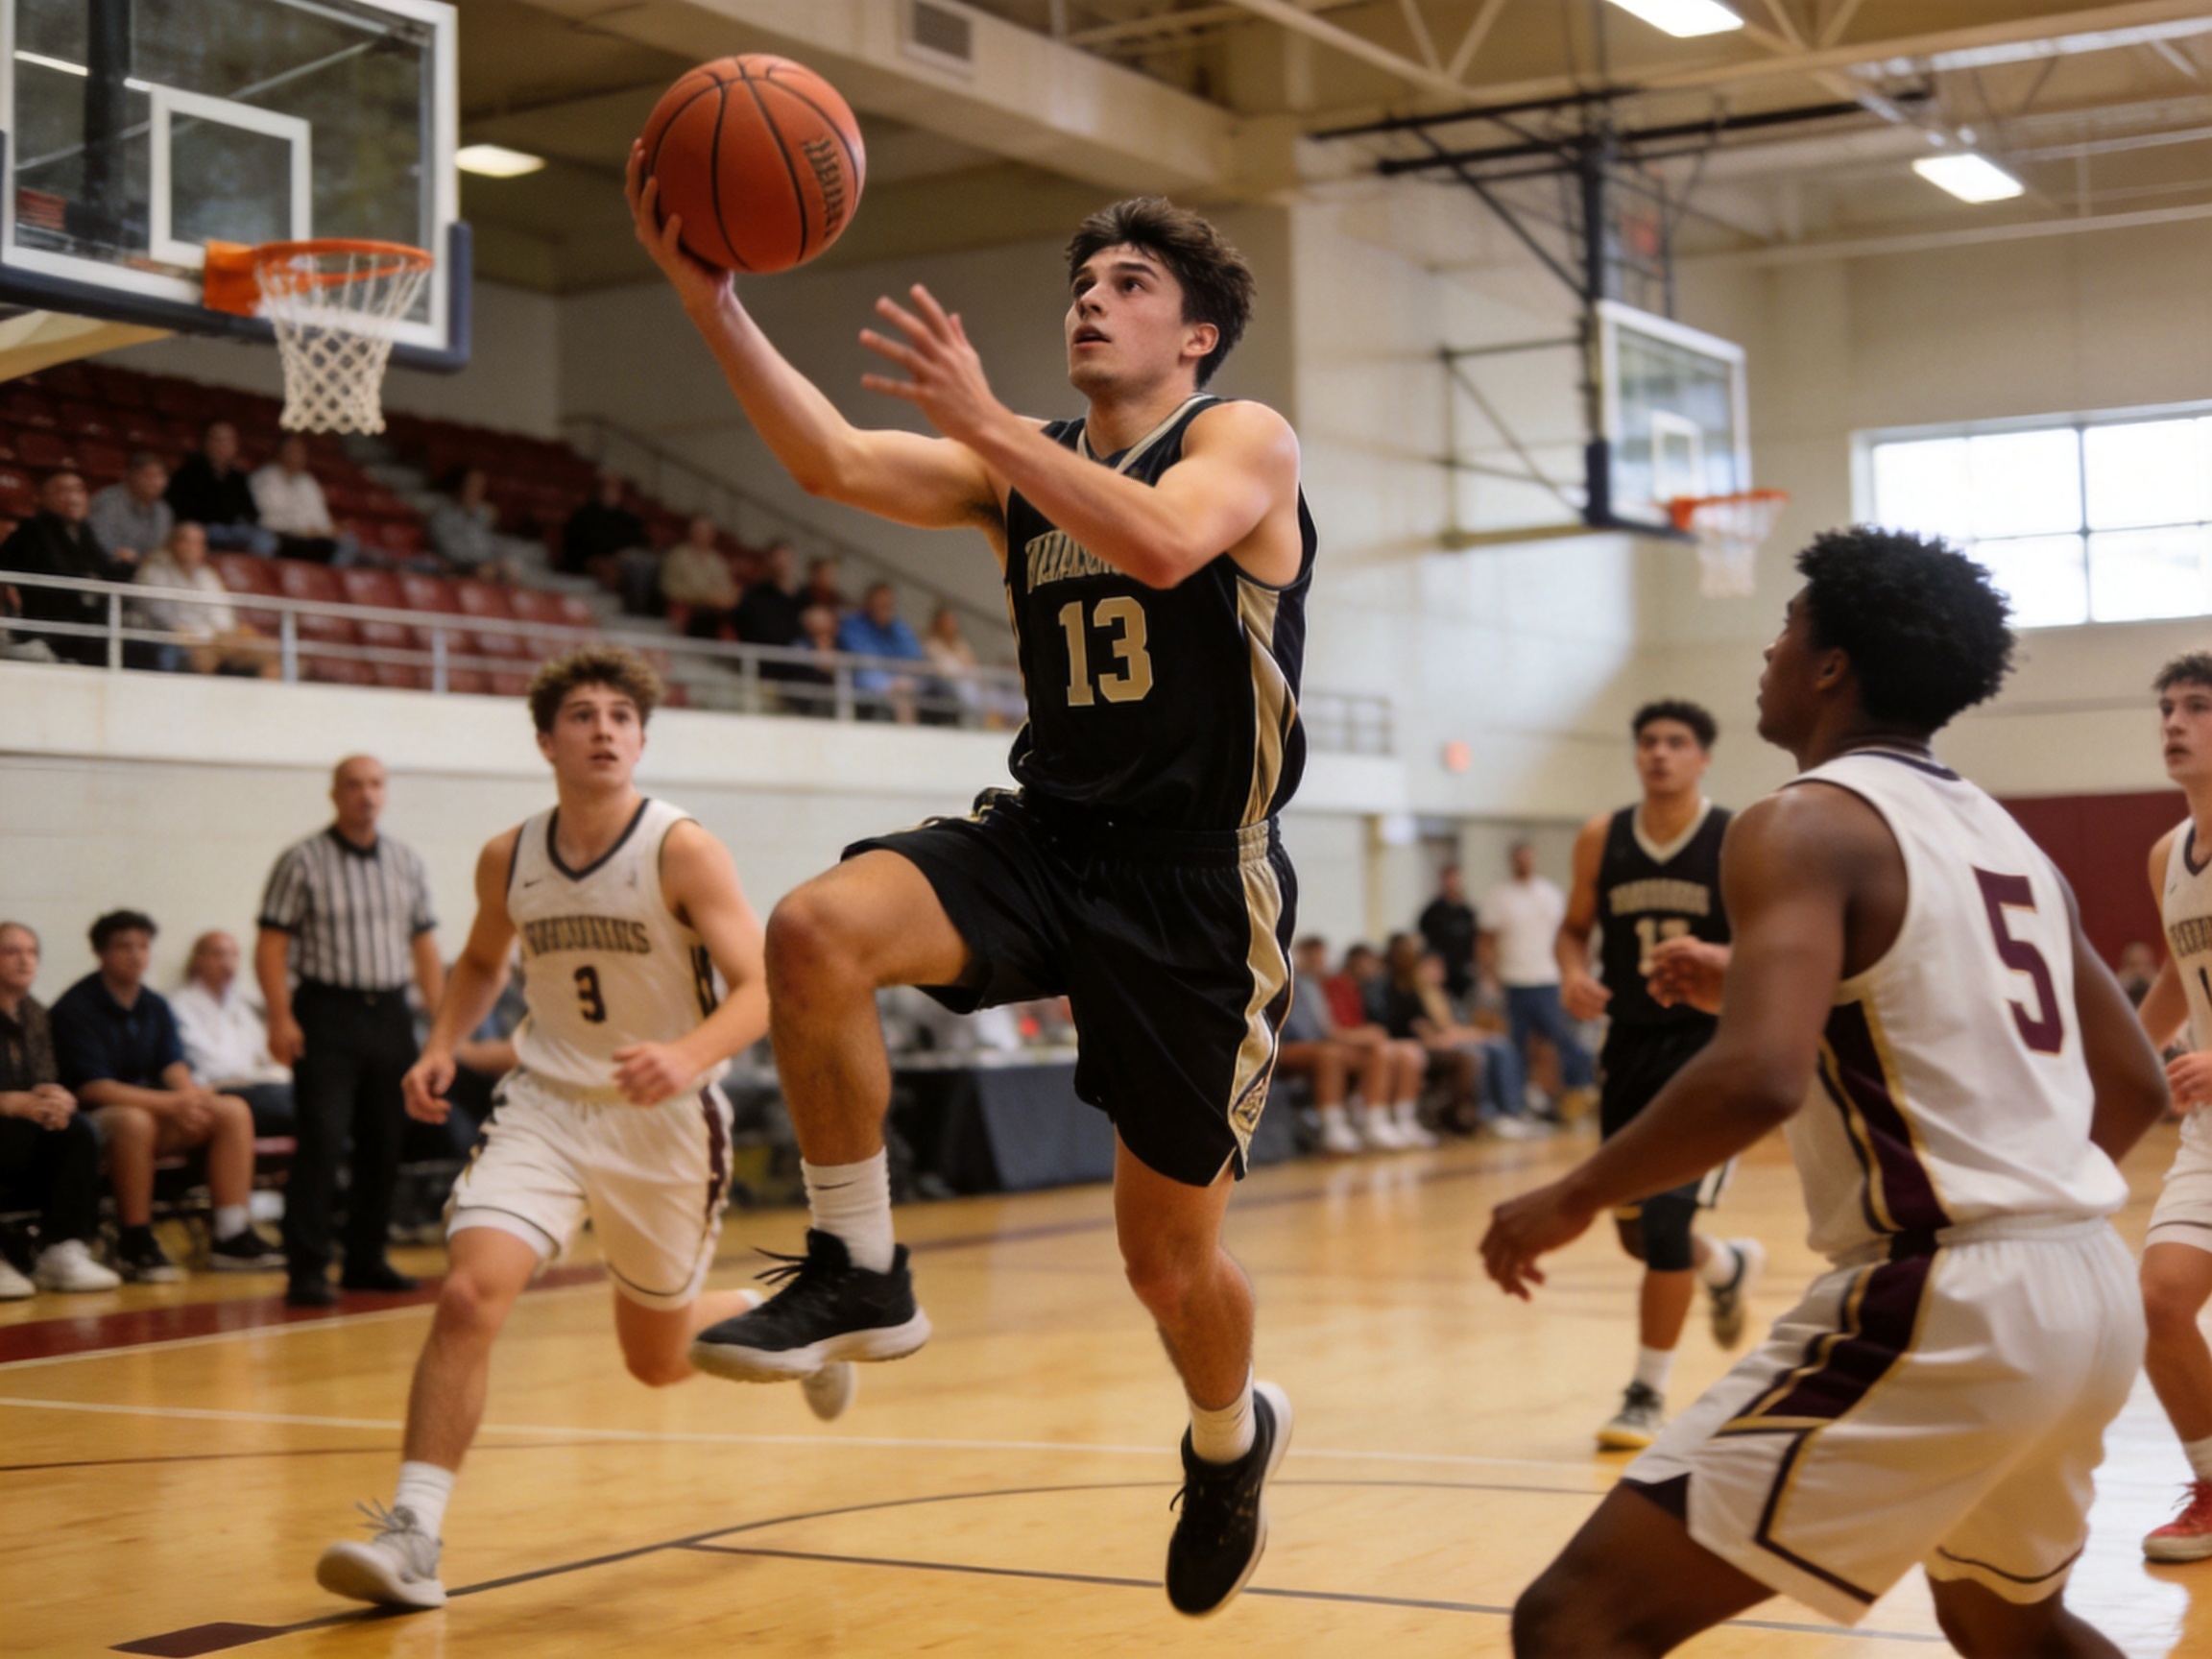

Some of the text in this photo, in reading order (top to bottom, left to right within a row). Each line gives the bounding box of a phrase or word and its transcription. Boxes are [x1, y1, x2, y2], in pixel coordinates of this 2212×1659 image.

[1059, 595, 1153, 707] 13
[574, 964, 607, 1024] 3
[1971, 865, 2065, 1056] 5
